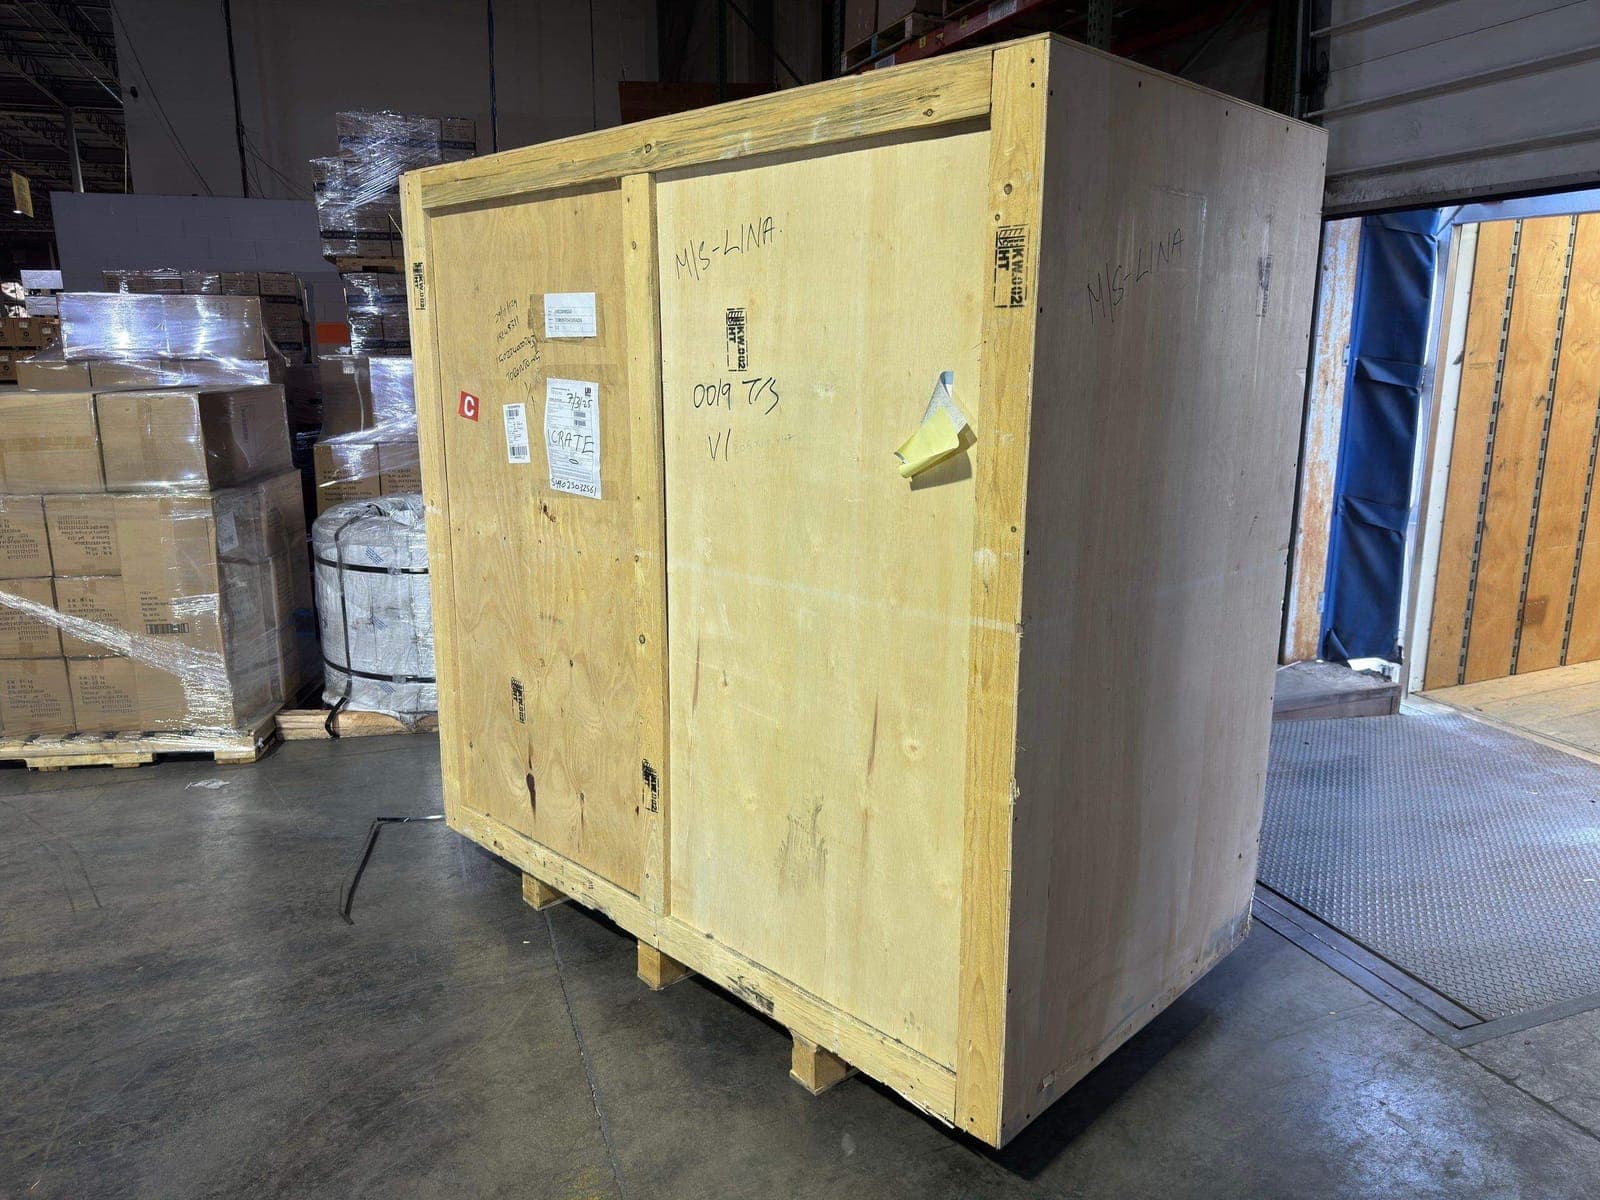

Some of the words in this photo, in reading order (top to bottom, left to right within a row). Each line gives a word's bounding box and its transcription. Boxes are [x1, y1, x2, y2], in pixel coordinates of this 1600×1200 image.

[998, 249, 1010, 271] HT
[728, 326, 737, 344] HT
[464, 396, 474, 416] C
